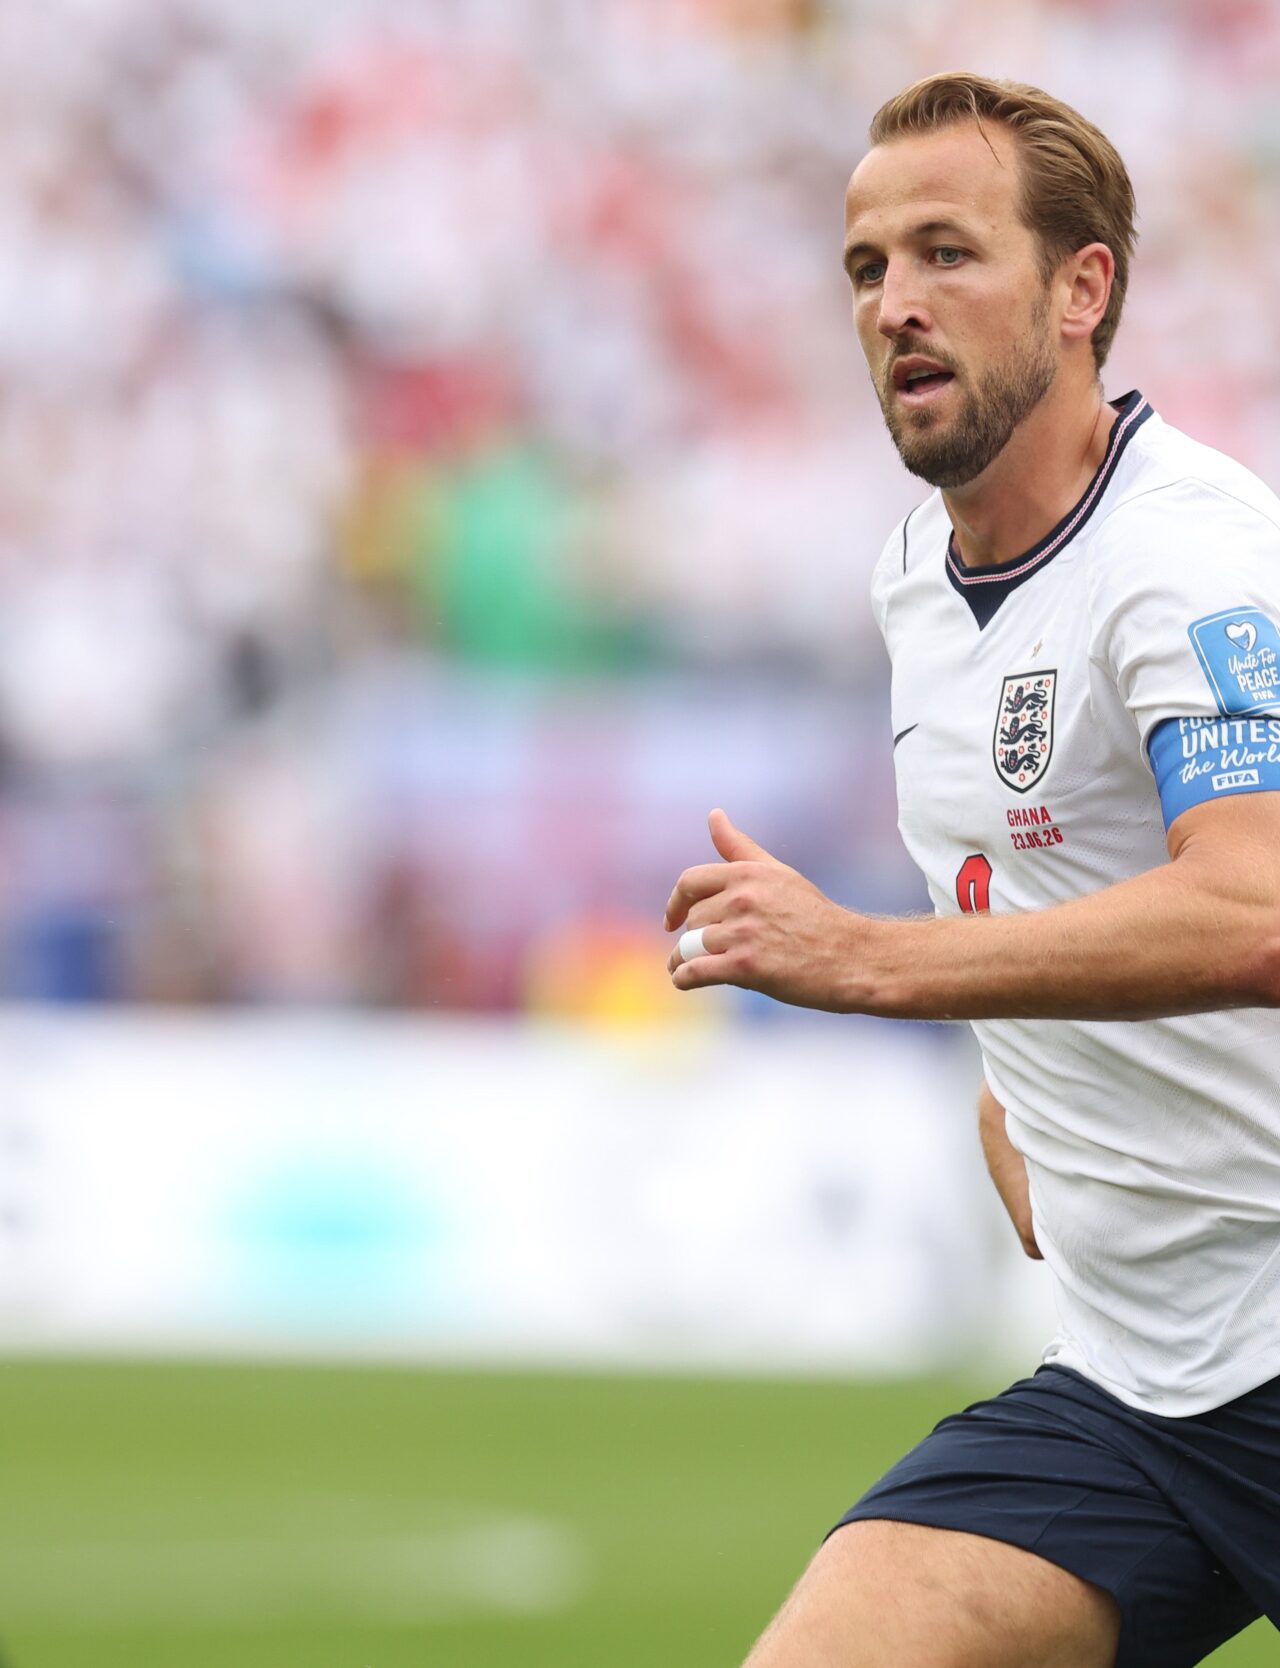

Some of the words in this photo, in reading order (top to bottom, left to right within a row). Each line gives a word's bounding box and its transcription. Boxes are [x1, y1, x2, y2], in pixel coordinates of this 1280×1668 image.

[1228, 652, 1259, 675] Unite
[1259, 647, 1276, 668] For
[1237, 667, 1280, 692] PEACE
[1252, 690, 1275, 701] FIFA
[1179, 758, 1215, 784] the
[1216, 772, 1257, 787] FIFA
[1006, 806, 1052, 827] GHANA
[1011, 827, 1063, 851] 23.06.26
